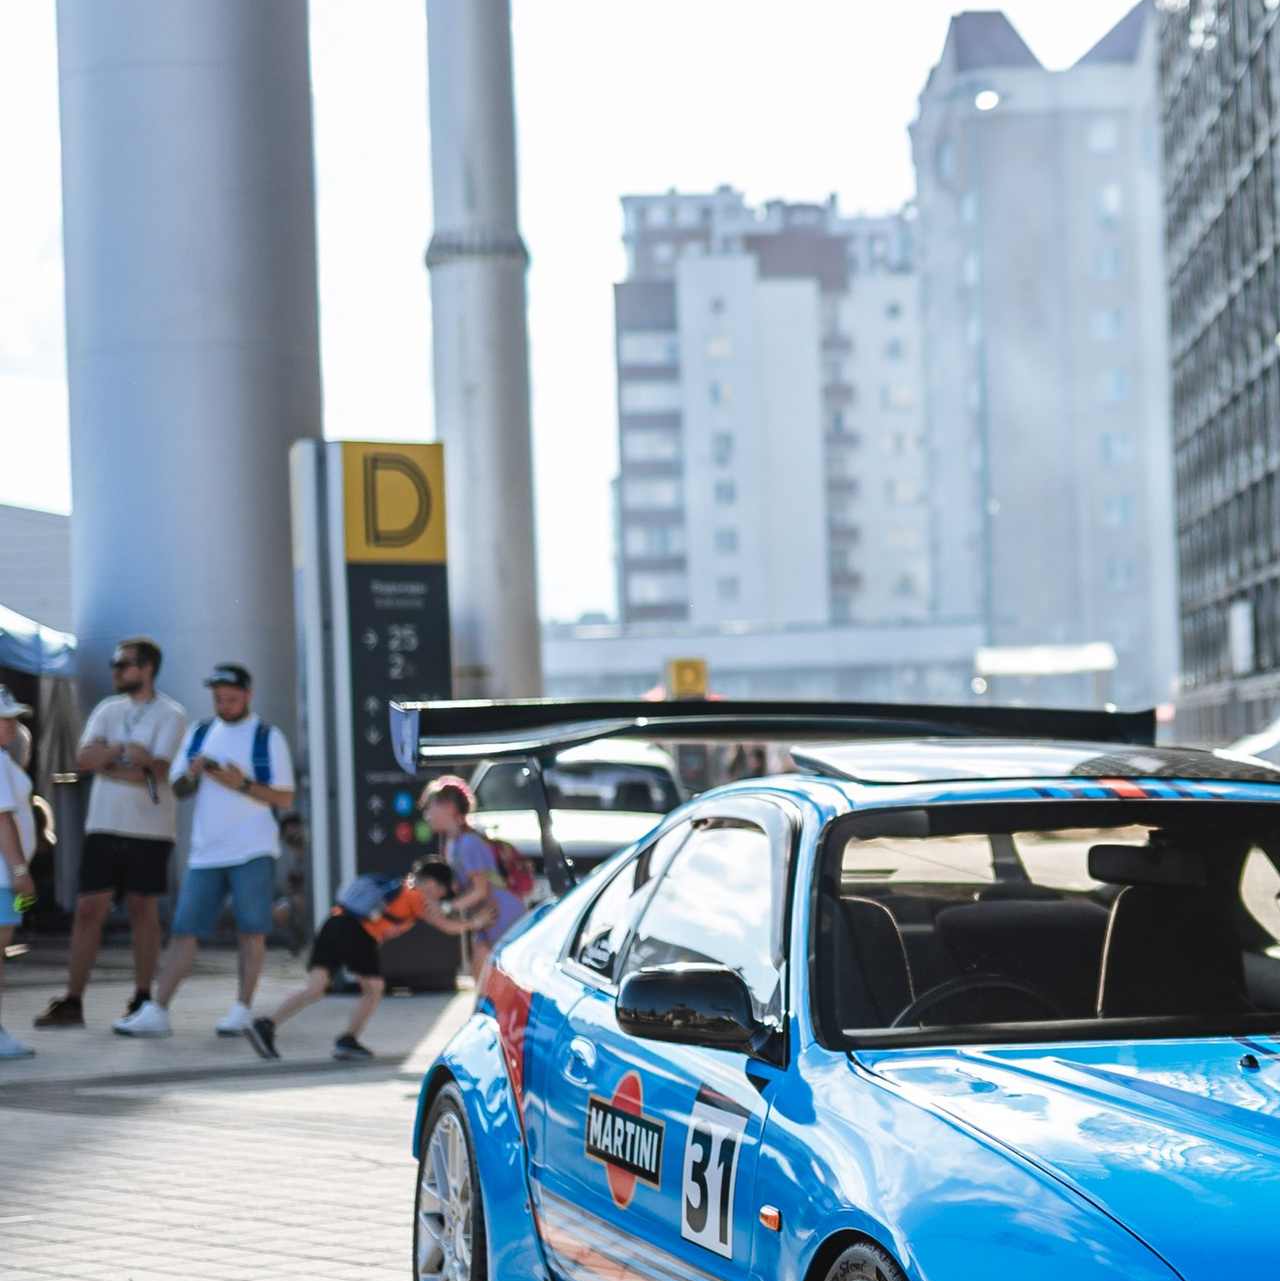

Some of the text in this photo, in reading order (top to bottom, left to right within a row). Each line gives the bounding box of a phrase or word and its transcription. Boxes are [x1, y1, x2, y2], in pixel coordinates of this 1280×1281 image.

[363, 453, 432, 547] D
[589, 1107, 659, 1173] MARTINI
[686, 1120, 737, 1246] 31
